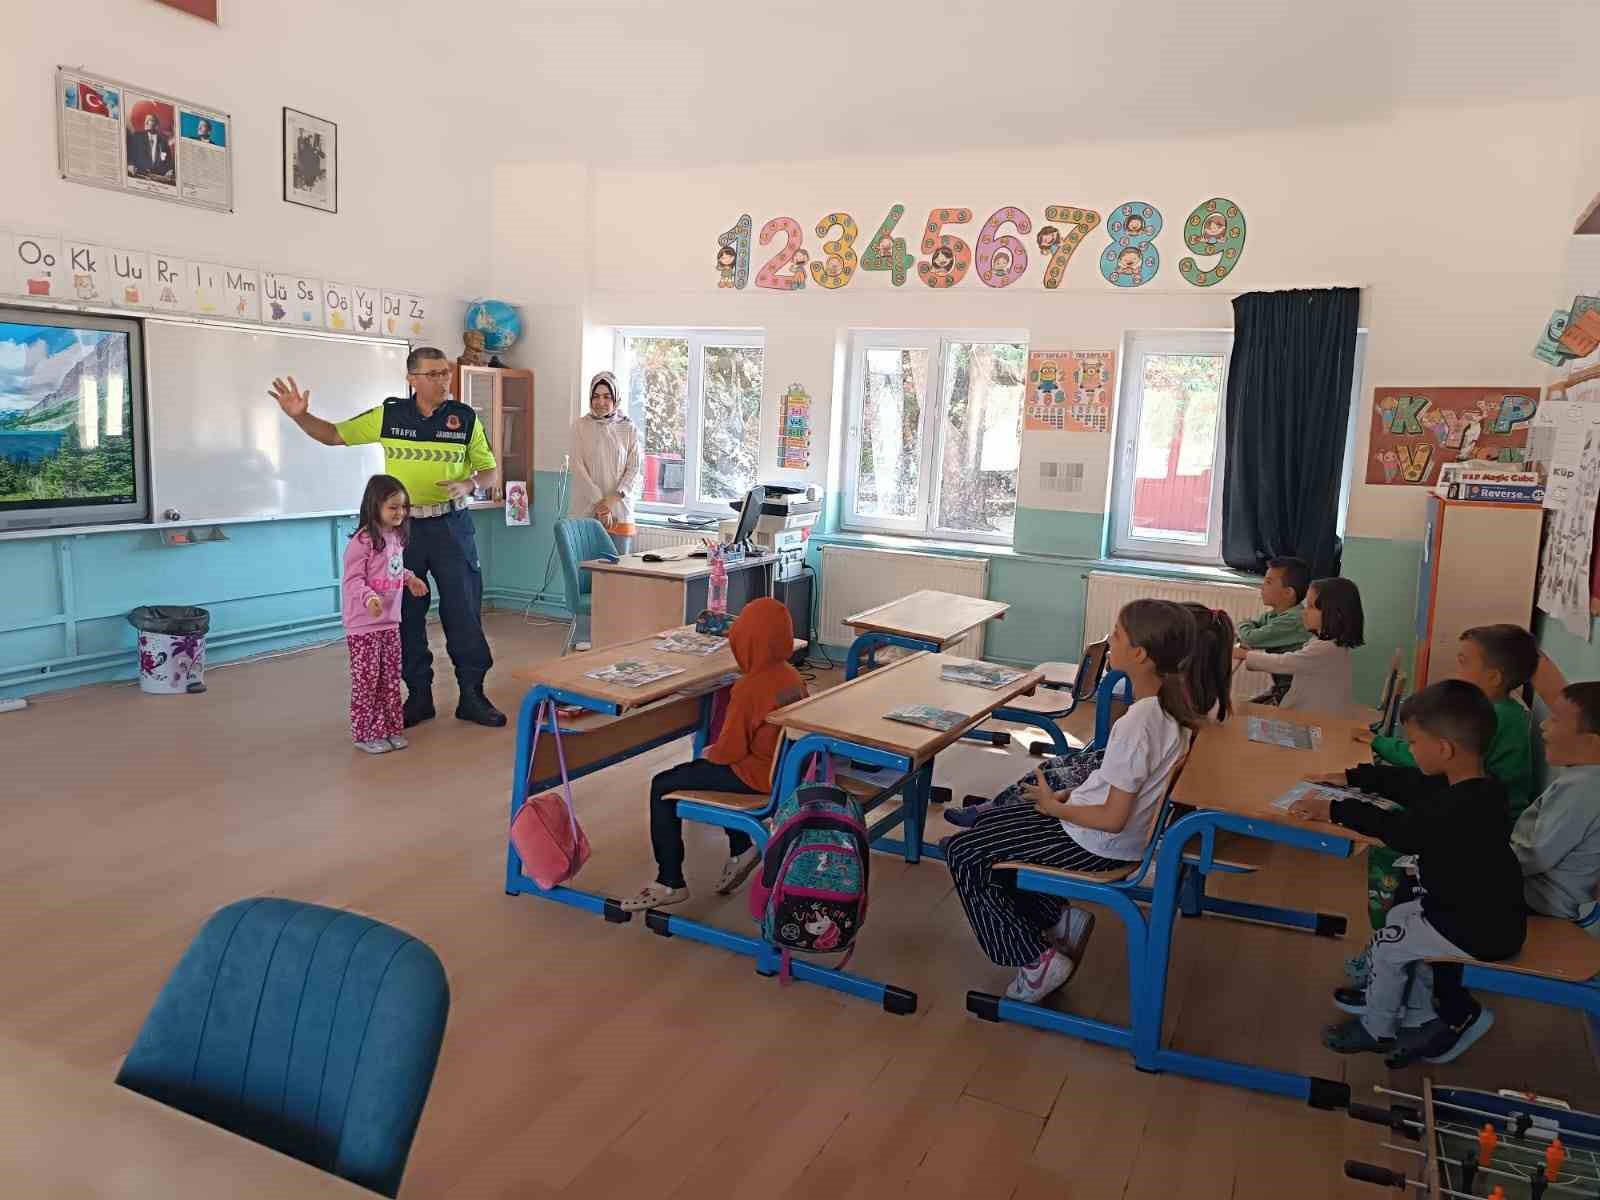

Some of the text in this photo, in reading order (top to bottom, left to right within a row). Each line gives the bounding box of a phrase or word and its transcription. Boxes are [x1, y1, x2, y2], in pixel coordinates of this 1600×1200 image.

[717, 197, 1247, 291] 1 2 3 4 5 6 7 8 9
[18, 240, 56, 267] Oo
[70, 247, 97, 273] Kk
[113, 254, 143, 279] Uu
[157, 259, 179, 284] Rr
[226, 271, 256, 292] Mm
[264, 272, 288, 301] Üü
[296, 280, 315, 301] Ss
[326, 283, 348, 311] Öö
[355, 290, 374, 316] Yy
[383, 296, 401, 316] Dd
[409, 300, 425, 320] Zz
[1391, 394, 1537, 450] K Y P
[1395, 442, 1434, 482] V
